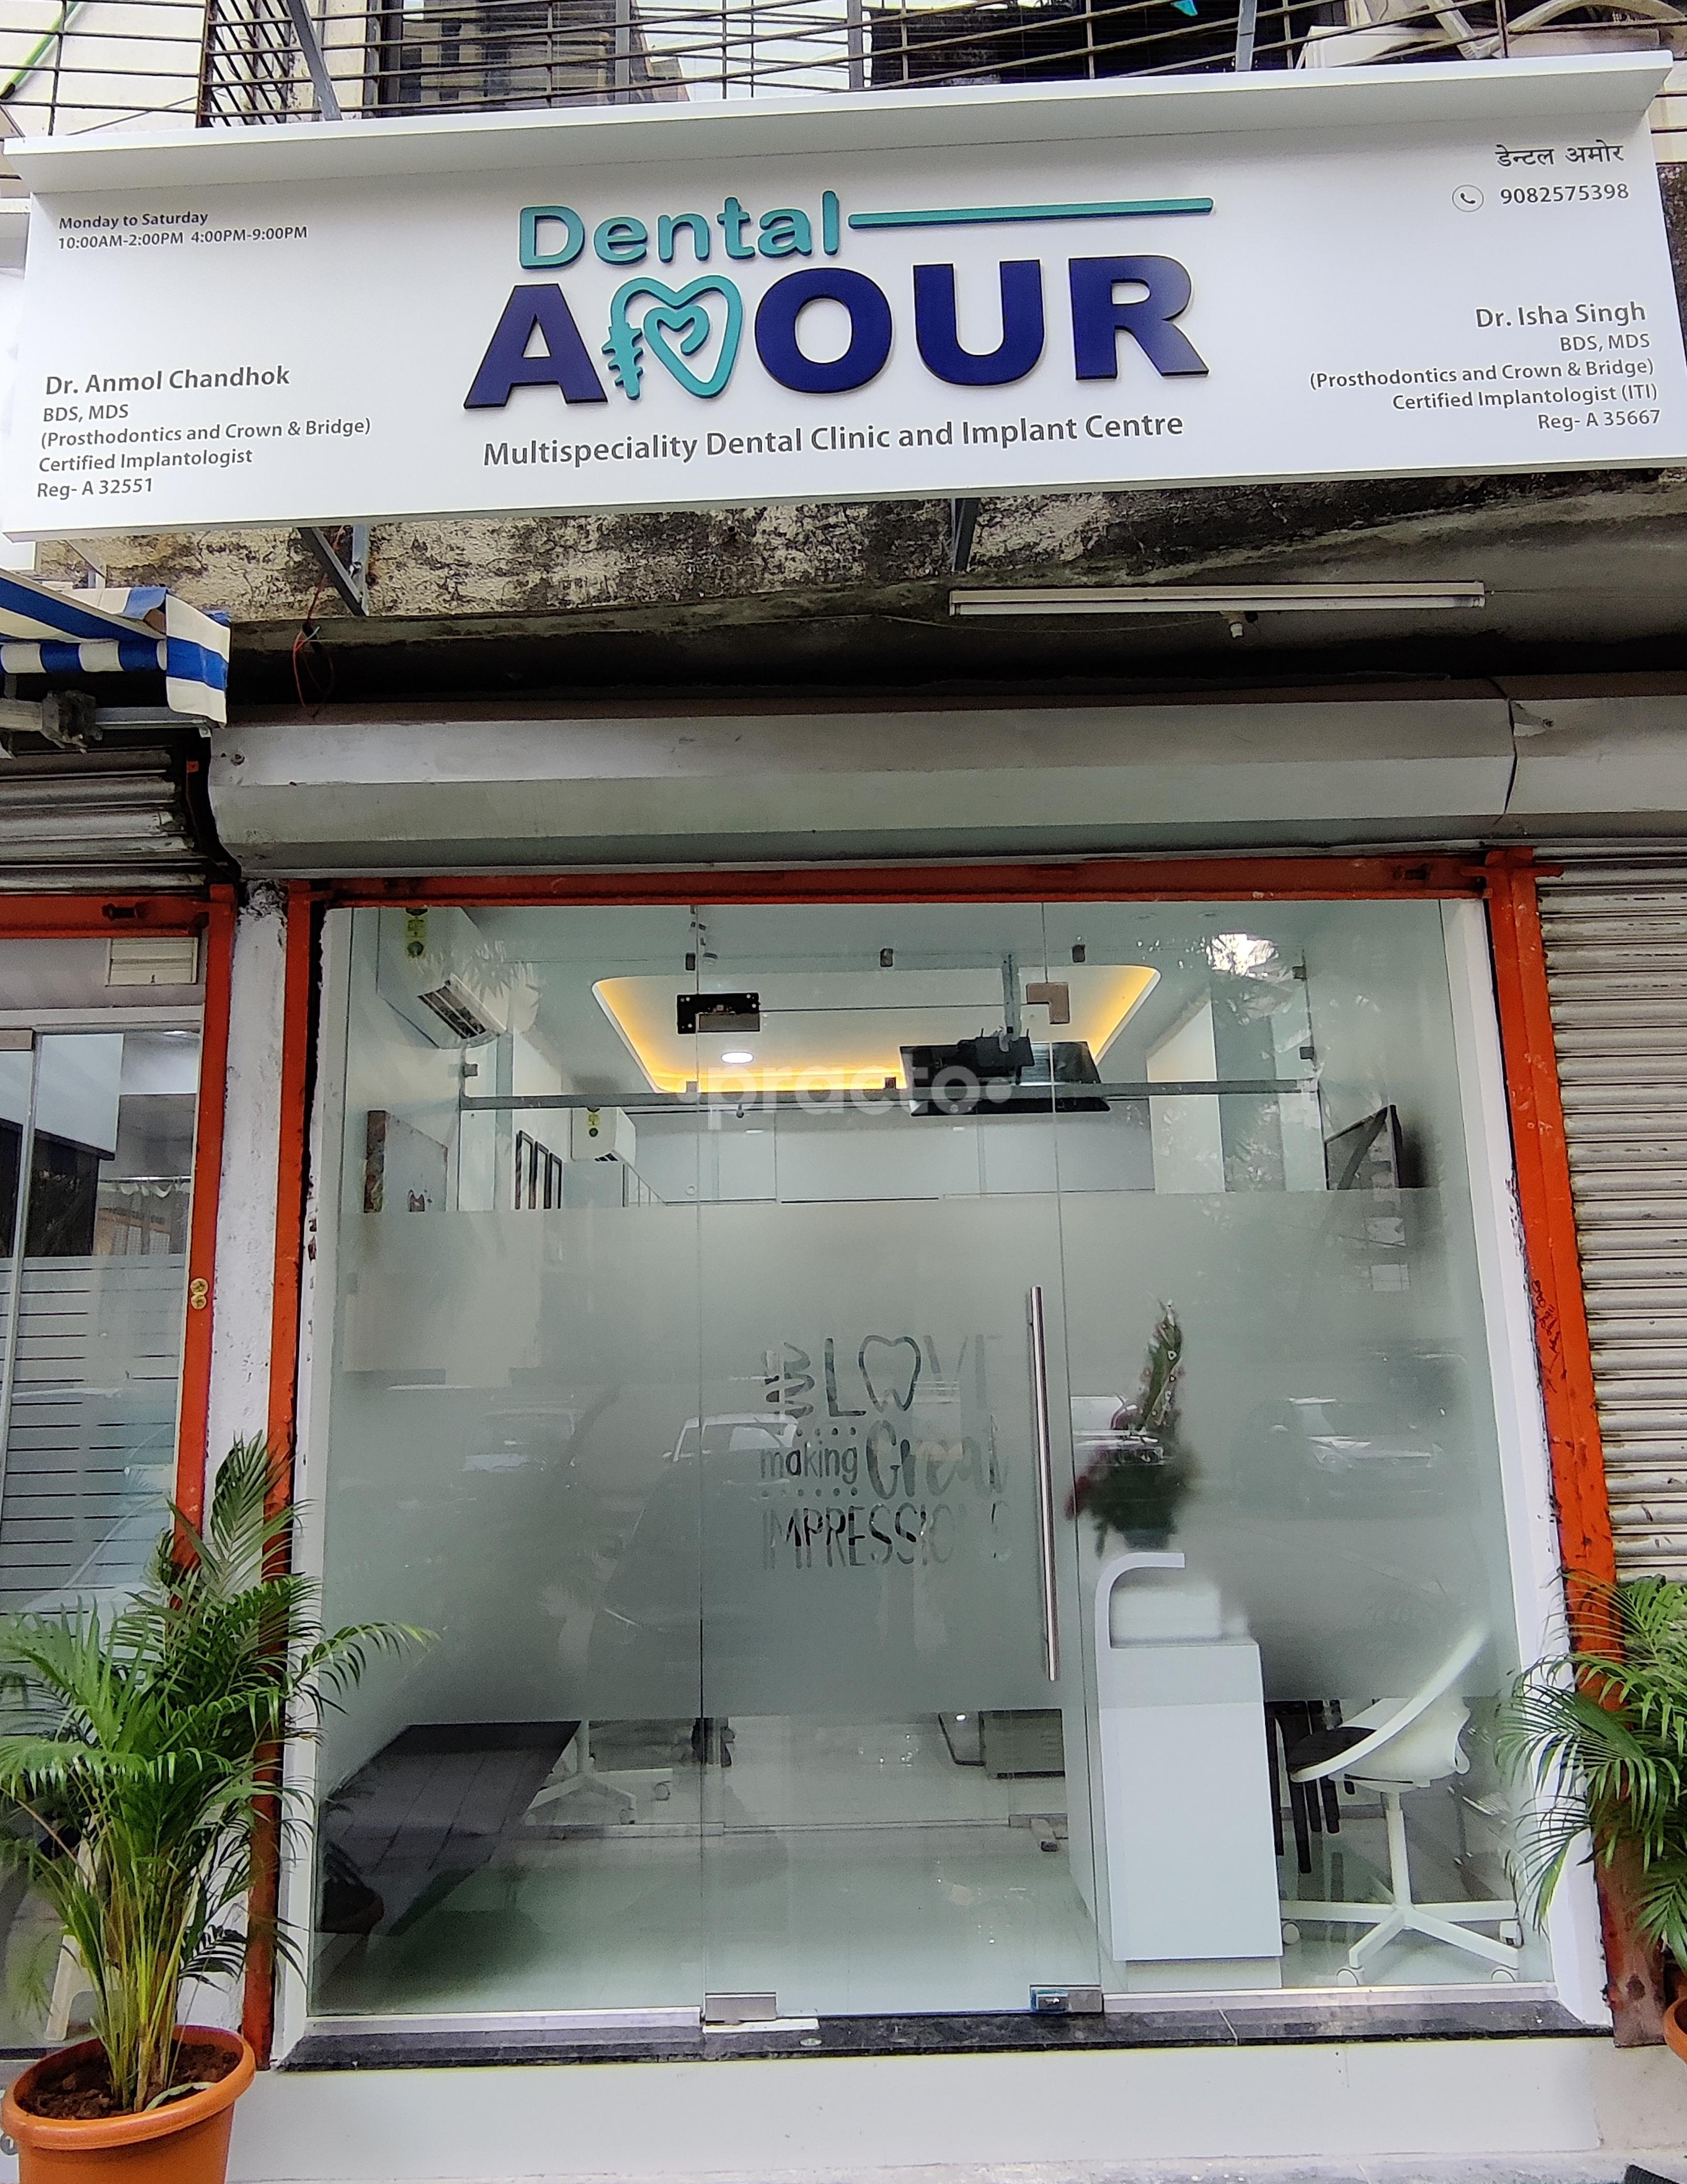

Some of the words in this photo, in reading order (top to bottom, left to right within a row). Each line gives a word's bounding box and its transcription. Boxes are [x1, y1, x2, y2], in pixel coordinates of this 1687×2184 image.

[1494, 144, 1555, 167] डेन्टल
[1565, 139, 1624, 163] अमोर
[1500, 183, 1629, 204] 9082575398
[59, 215, 119, 230] Monday
[123, 216, 138, 227] to
[142, 211, 209, 226] Saturday
[519, 189, 841, 272] Dental
[59, 232, 183, 249] 10:00AM-2:00PM
[191, 226, 307, 243] 4:00PM-9:00PM
[1476, 309, 1512, 328] Dr.
[1518, 305, 1568, 325] Isha
[1575, 301, 1646, 326] Singh
[1560, 335, 1603, 352] BDS,
[1608, 333, 1650, 349] MDS
[46, 376, 78, 395] Dr.
[85, 370, 162, 393] Anmol
[169, 365, 290, 389] Chandhok
[1310, 368, 1457, 390] (Prosthodontics
[1462, 365, 1497, 381] and
[1502, 365, 1562, 379] Crown
[1567, 362, 1581, 376] &
[1586, 358, 1653, 378] Bridge)
[1393, 391, 1473, 409] Certified
[1478, 385, 1617, 409] Implantologist
[1622, 383, 1656, 402] (ITI)
[43, 406, 83, 423] BDS,
[88, 404, 128, 420] MDS
[1538, 414, 1580, 432] Reg-
[1586, 412, 1599, 427] A
[1603, 409, 1660, 426] 35667
[41, 426, 182, 450] (Prosthodontics
[186, 424, 220, 440] and
[225, 424, 282, 438] Crown
[288, 421, 301, 436] &
[306, 418, 370, 437] Bridge)
[484, 434, 698, 468] Multispeciality
[707, 428, 802, 455] Dental
[811, 425, 890, 450] Clinic
[899, 421, 953, 447] and
[963, 418, 1077, 449] Implant
[1086, 415, 1183, 438] Centre
[39, 454, 115, 472] Certified
[121, 448, 253, 471] Implantologist
[37, 483, 77, 500] Reg-
[81, 481, 94, 495] A
[99, 478, 152, 494] 32551
[760, 1444, 858, 1485] making
[762, 1502, 1012, 1570] IMPRESSIO
